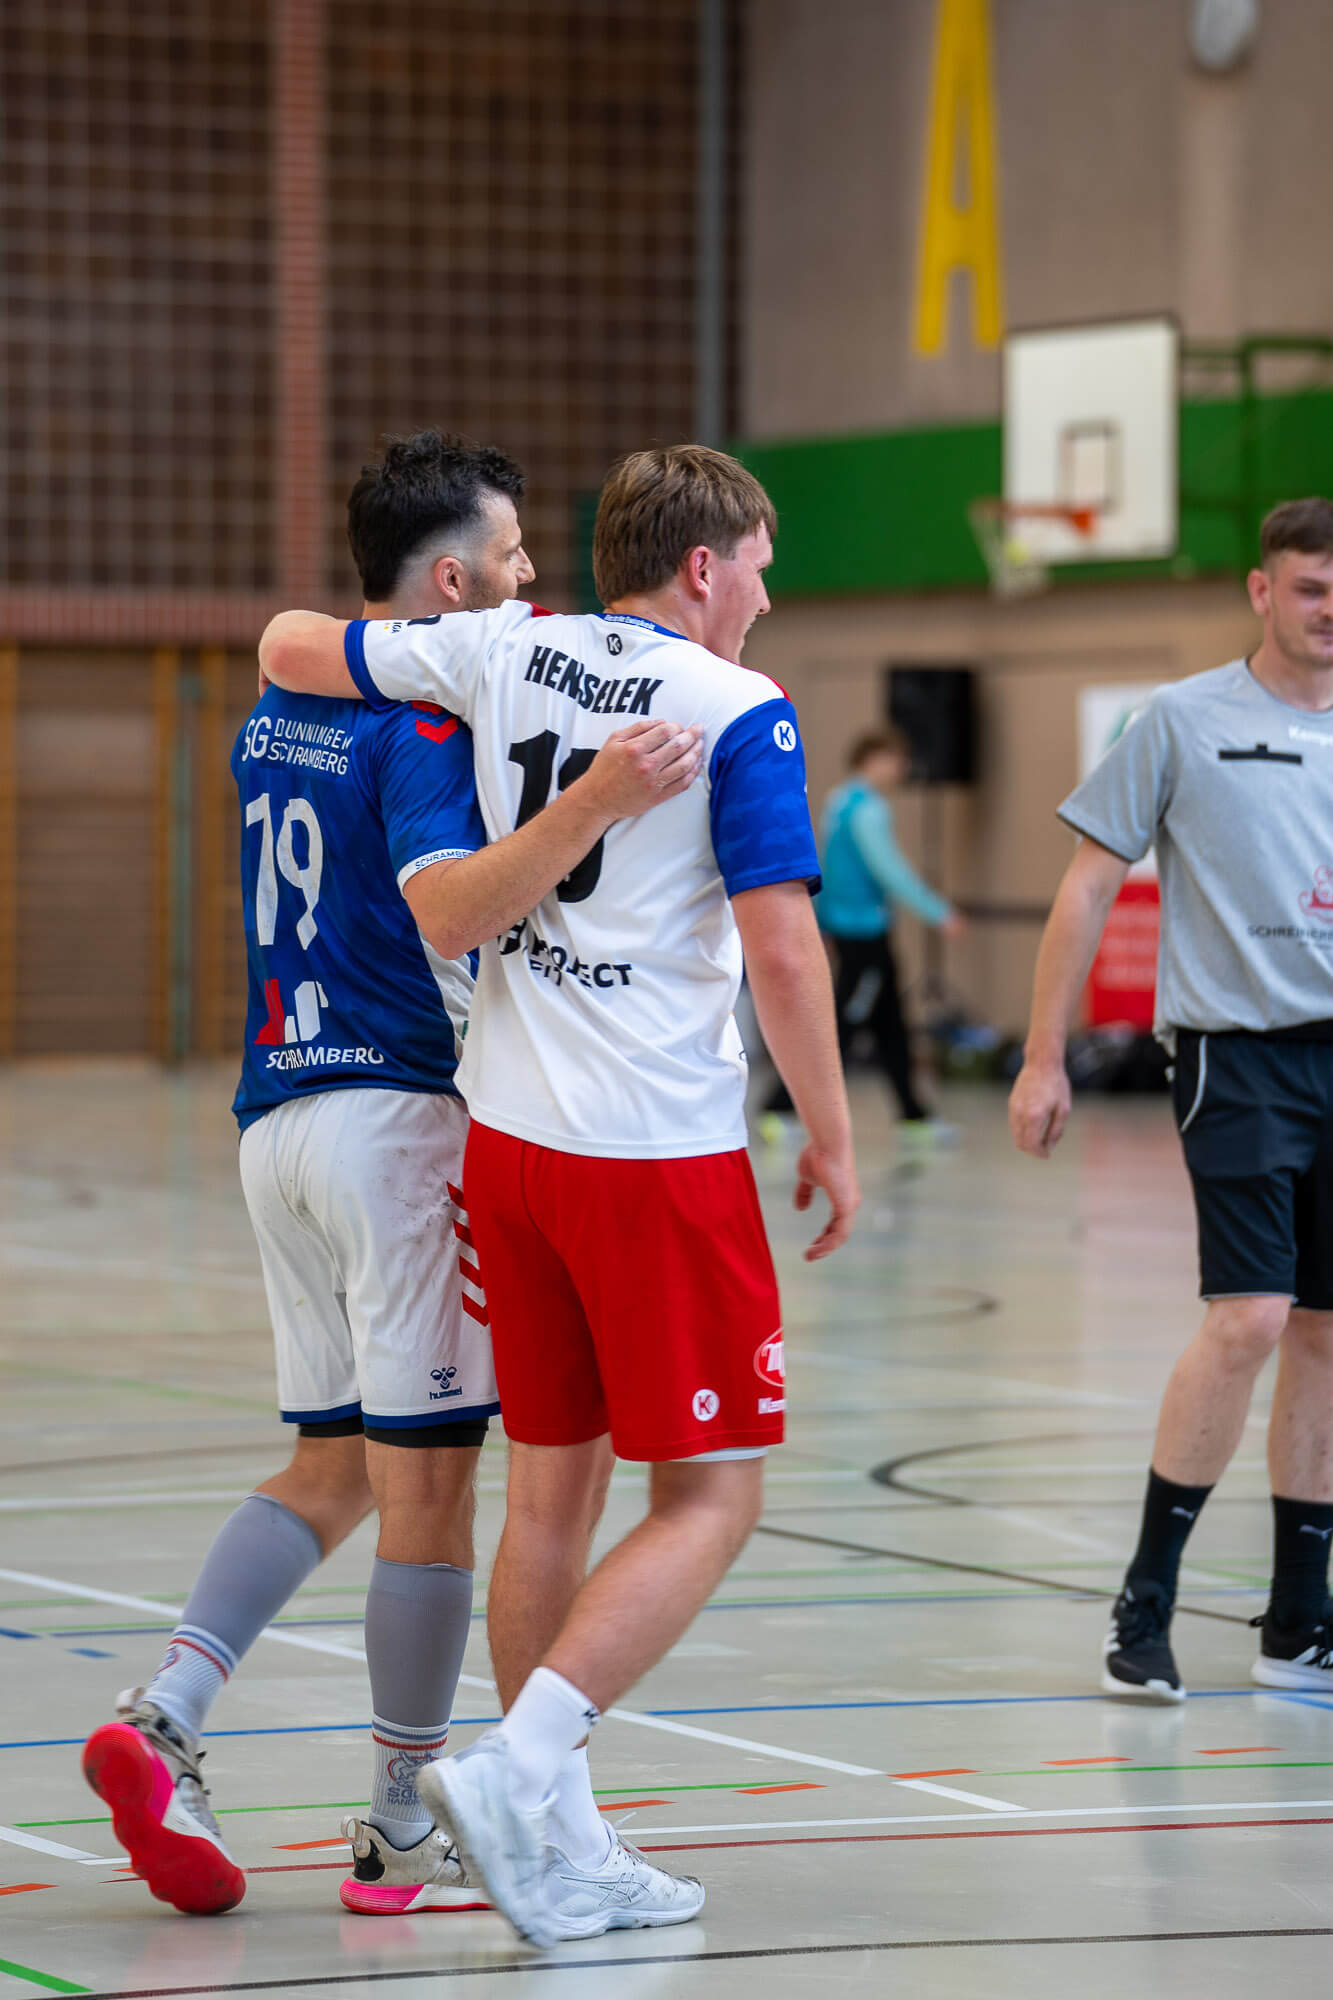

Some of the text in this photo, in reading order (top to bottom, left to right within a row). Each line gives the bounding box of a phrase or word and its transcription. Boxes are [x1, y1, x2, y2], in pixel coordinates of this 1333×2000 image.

[524, 645, 664, 716] HENSELEK
[242, 716, 272, 762] SG
[274, 718, 354, 750] DUNNINGEN
[246, 793, 323, 950] 19
[265, 1047, 385, 1071] SCHRAMBERG
